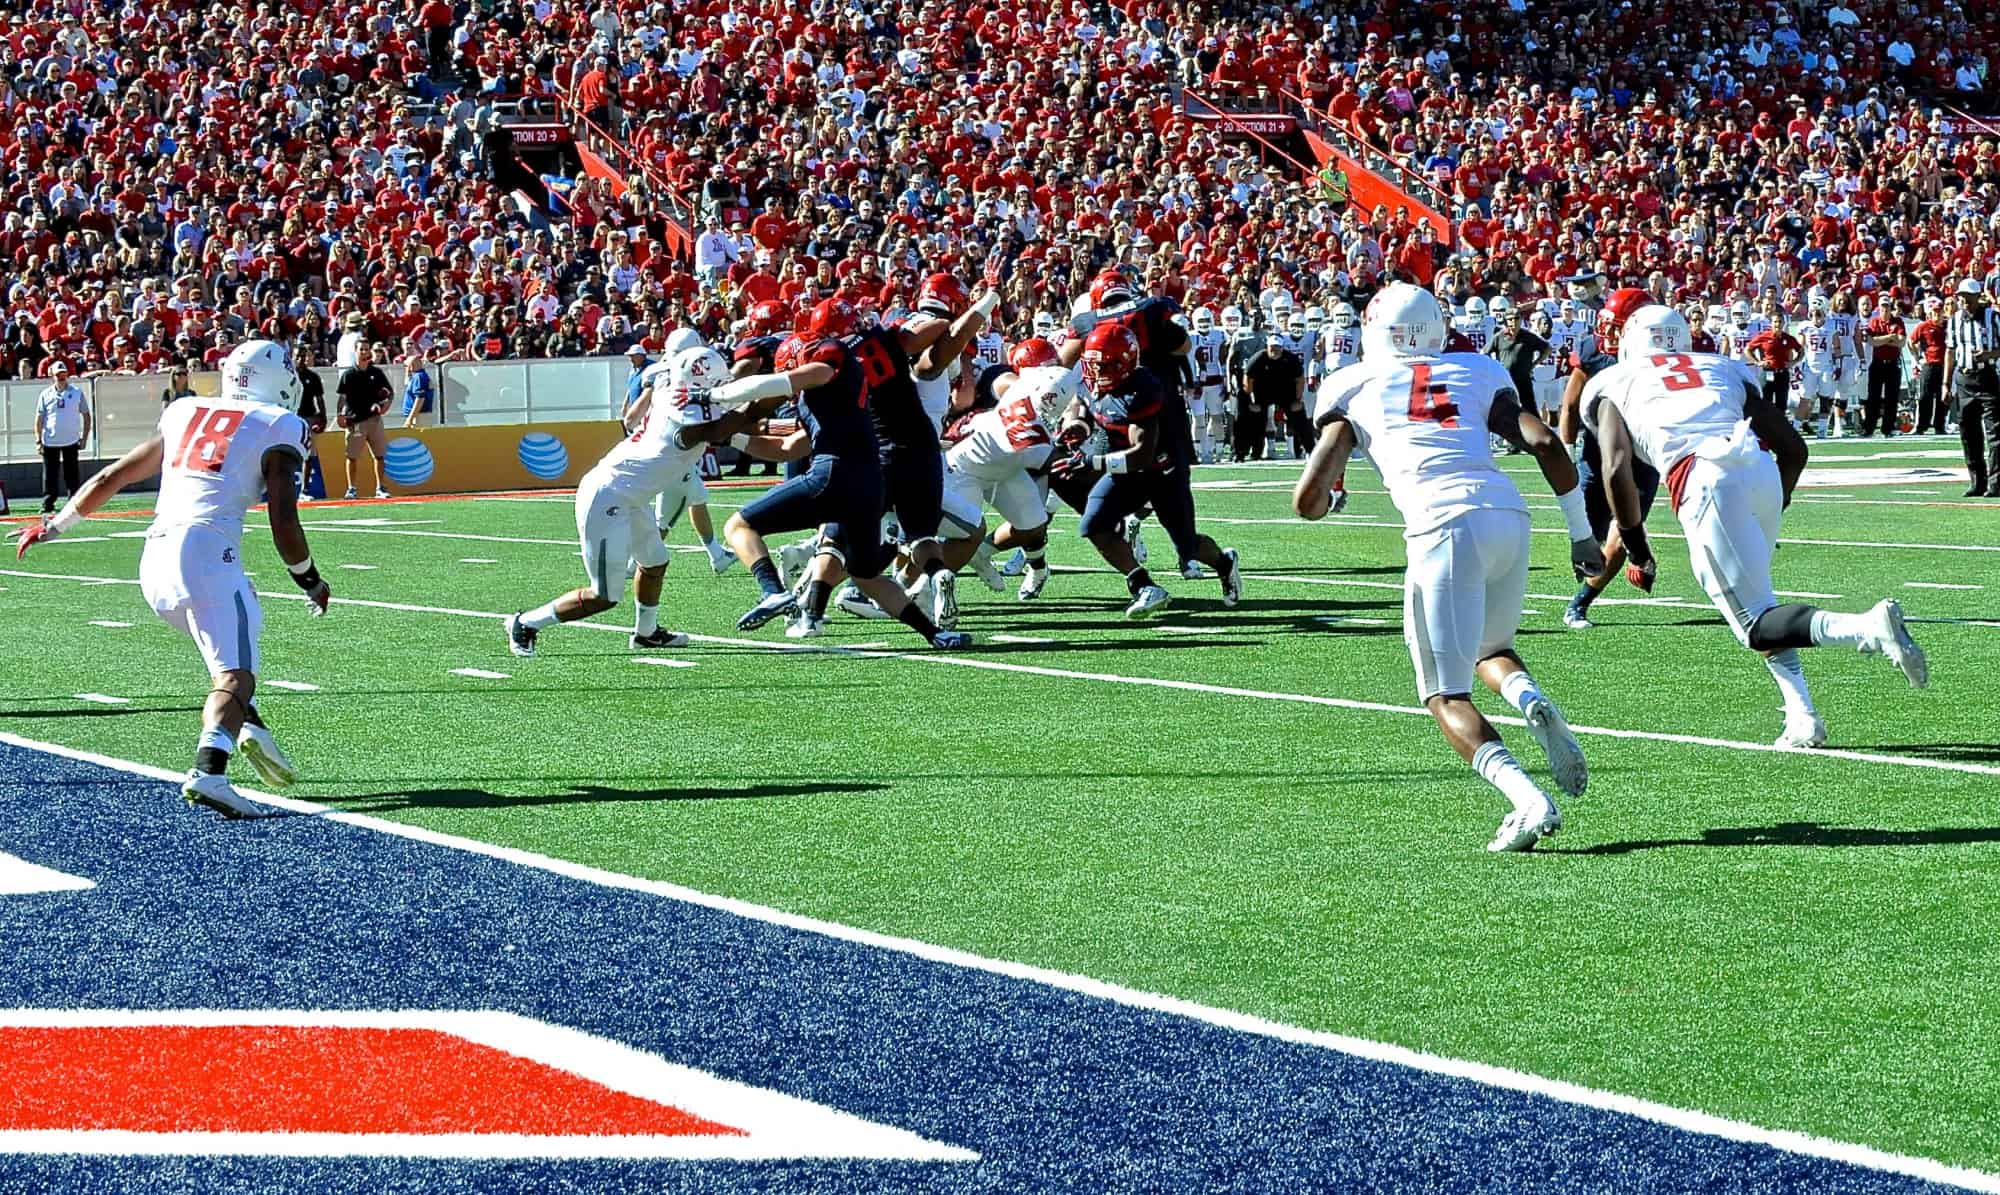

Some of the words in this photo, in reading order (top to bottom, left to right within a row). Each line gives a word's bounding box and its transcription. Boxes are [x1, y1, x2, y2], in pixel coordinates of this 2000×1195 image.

[1223, 122, 1234, 133] 20
[1268, 121, 1277, 132] 21
[537, 131, 548, 141] 20
[1333, 336, 1353, 354] 95
[1409, 334, 1417, 348] 4
[1667, 336, 1675, 348] 3
[979, 346, 999, 364] 58
[1649, 353, 1704, 392] 3
[239, 375, 249, 388] 18
[1407, 361, 1461, 429] 4
[172, 406, 246, 473] 18
